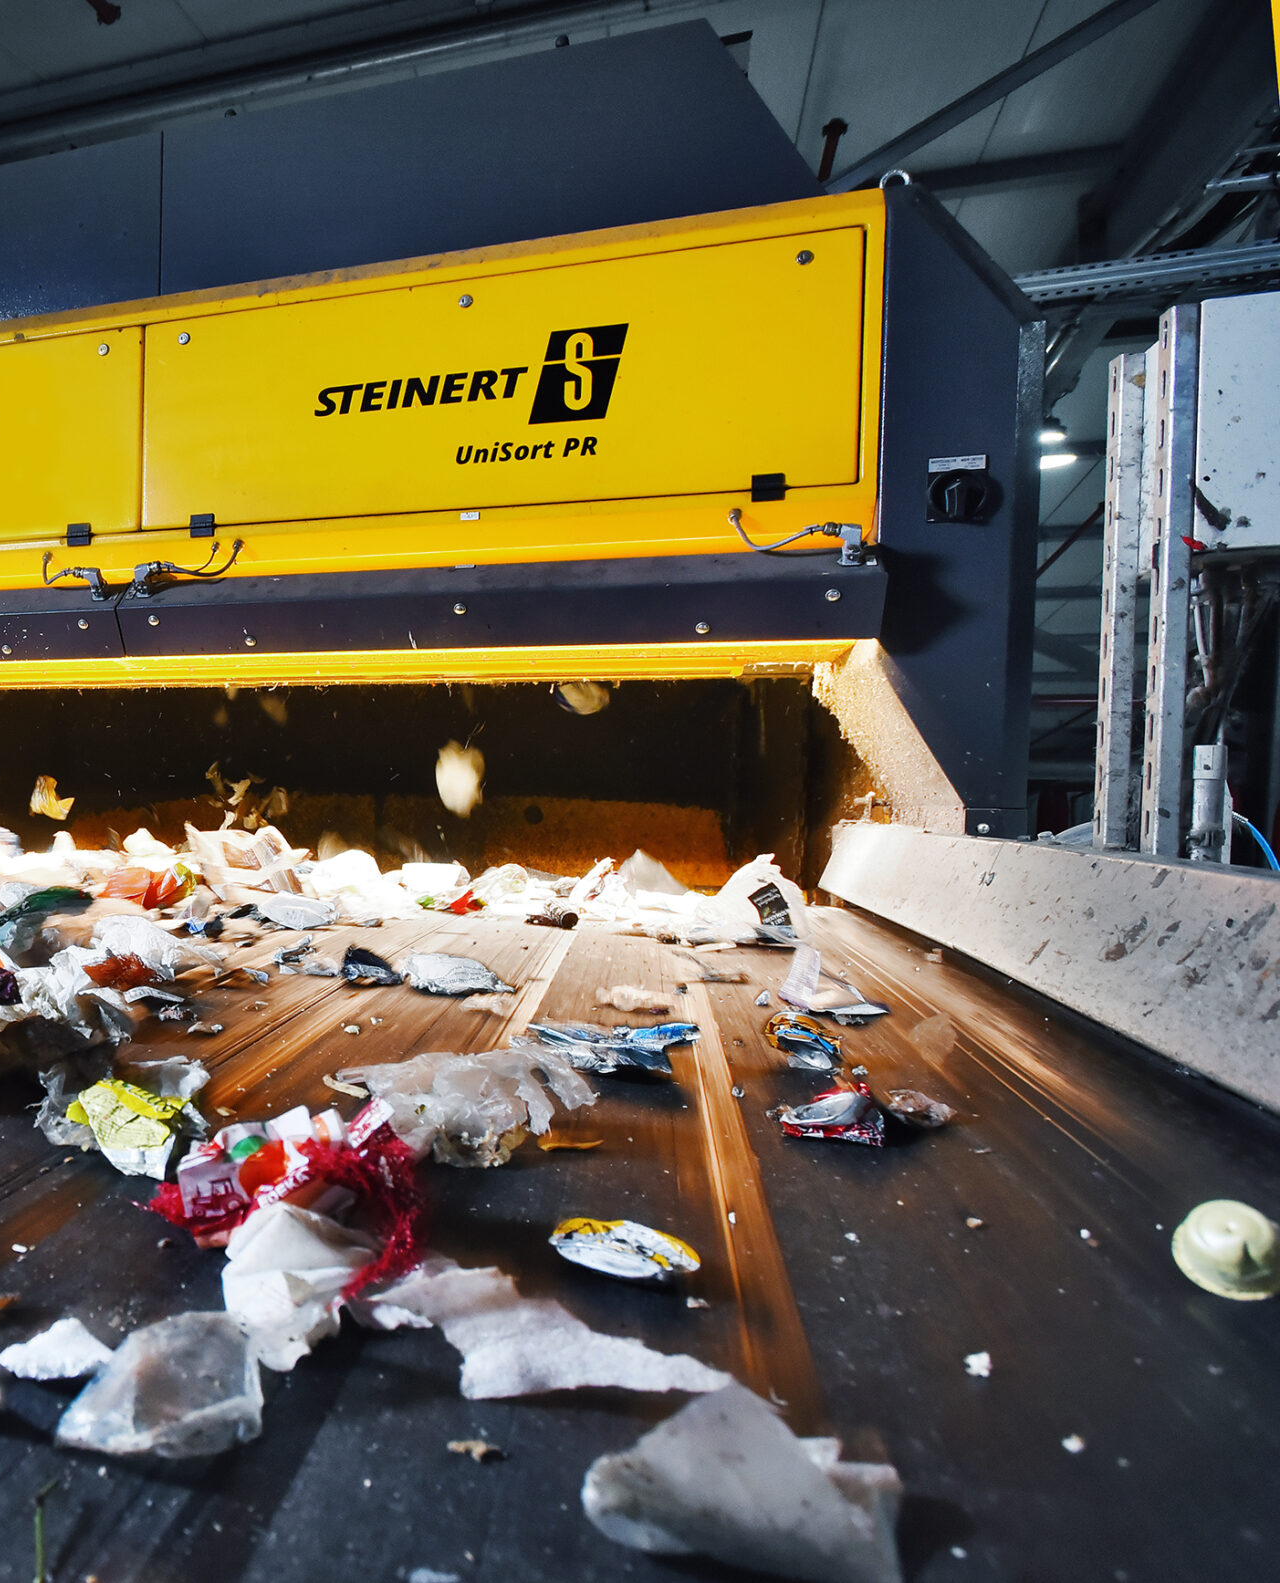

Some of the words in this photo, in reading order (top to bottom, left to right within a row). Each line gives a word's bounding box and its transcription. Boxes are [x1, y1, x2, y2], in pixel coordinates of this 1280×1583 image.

[313, 366, 529, 417] STEINERT
[455, 440, 555, 465] UniSort
[562, 436, 598, 457] PR
